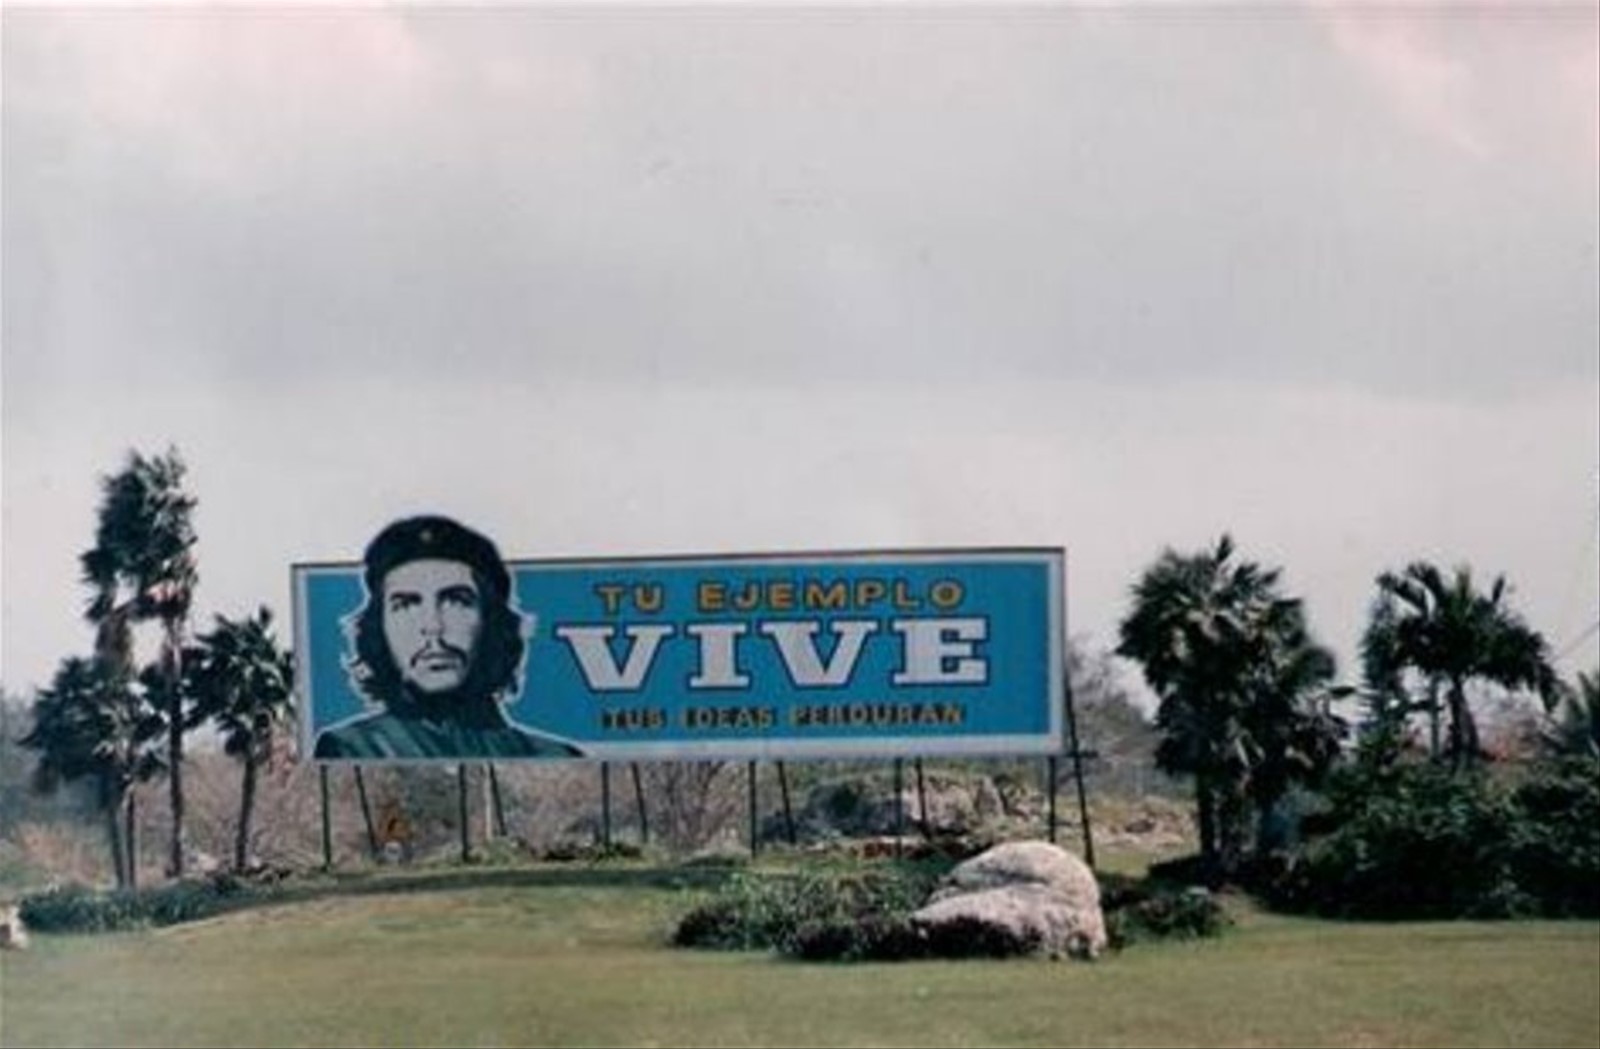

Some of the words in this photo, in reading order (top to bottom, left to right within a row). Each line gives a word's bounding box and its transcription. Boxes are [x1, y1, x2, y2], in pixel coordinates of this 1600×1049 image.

[597, 582, 664, 613] TU
[698, 579, 965, 612] EJEMPLO
[556, 617, 988, 691] VIVE
